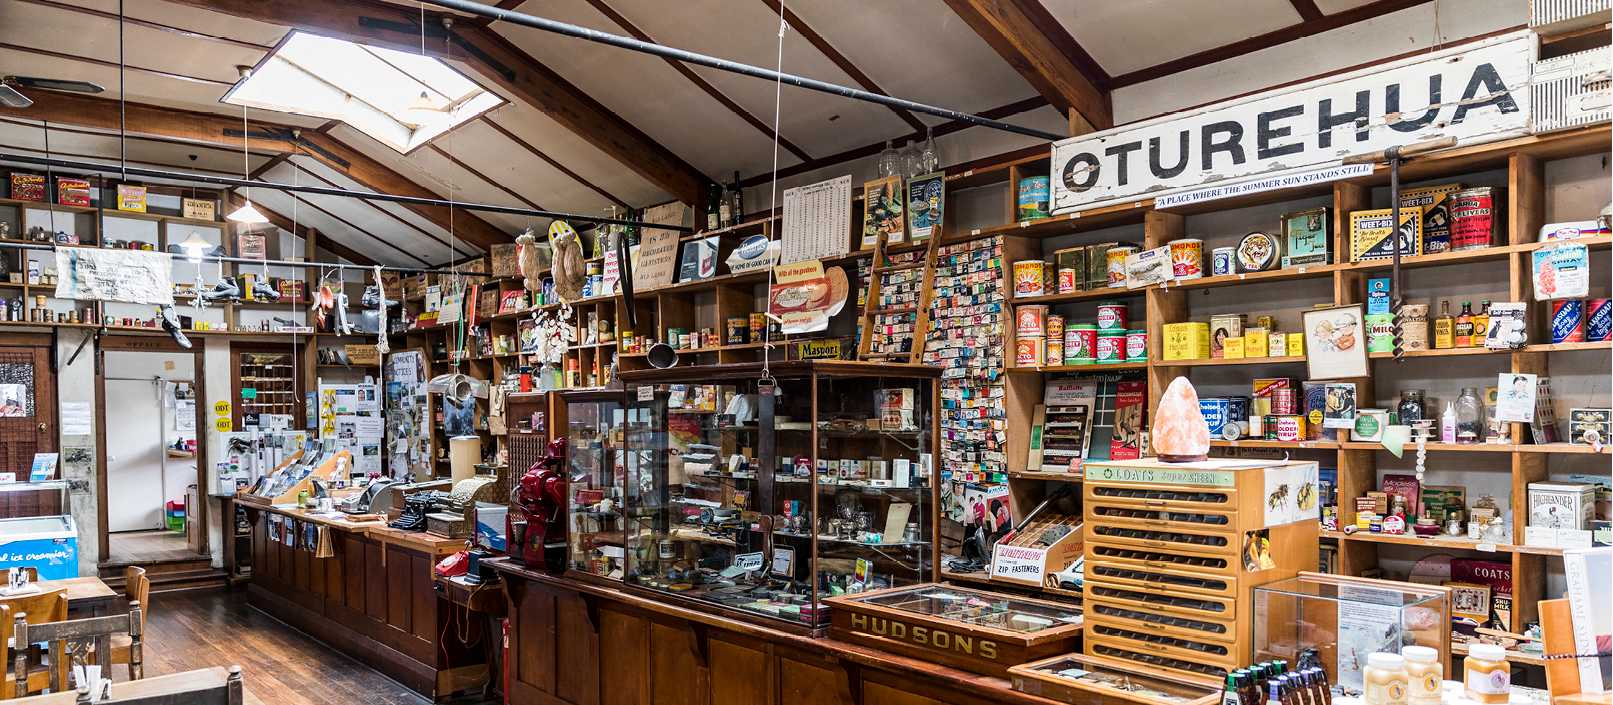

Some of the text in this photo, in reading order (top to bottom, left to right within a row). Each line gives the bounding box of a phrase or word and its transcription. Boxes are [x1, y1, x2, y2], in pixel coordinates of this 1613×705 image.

[1062, 62, 1520, 192] OTUREHUA
[1166, 193, 1191, 205] PLACE
[1191, 188, 1222, 202] WHERE
[1224, 184, 1241, 196] THE
[1242, 179, 1281, 193] SUMMER
[1281, 174, 1300, 188] SUN
[1302, 169, 1340, 183] STANDS
[1402, 197, 1433, 208] WEET-BIX
[1360, 219, 1393, 230] WEET-BIX
[801, 342, 839, 359] Masport
[1188, 471, 1215, 483] SHEEN
[1534, 494, 1573, 511] HIGHLANDER
[11, 552, 24, 562] ice
[998, 565, 1040, 574] ZIP FASTENERS
[1475, 567, 1511, 580] COATS
[850, 612, 998, 660] HUDSONS
